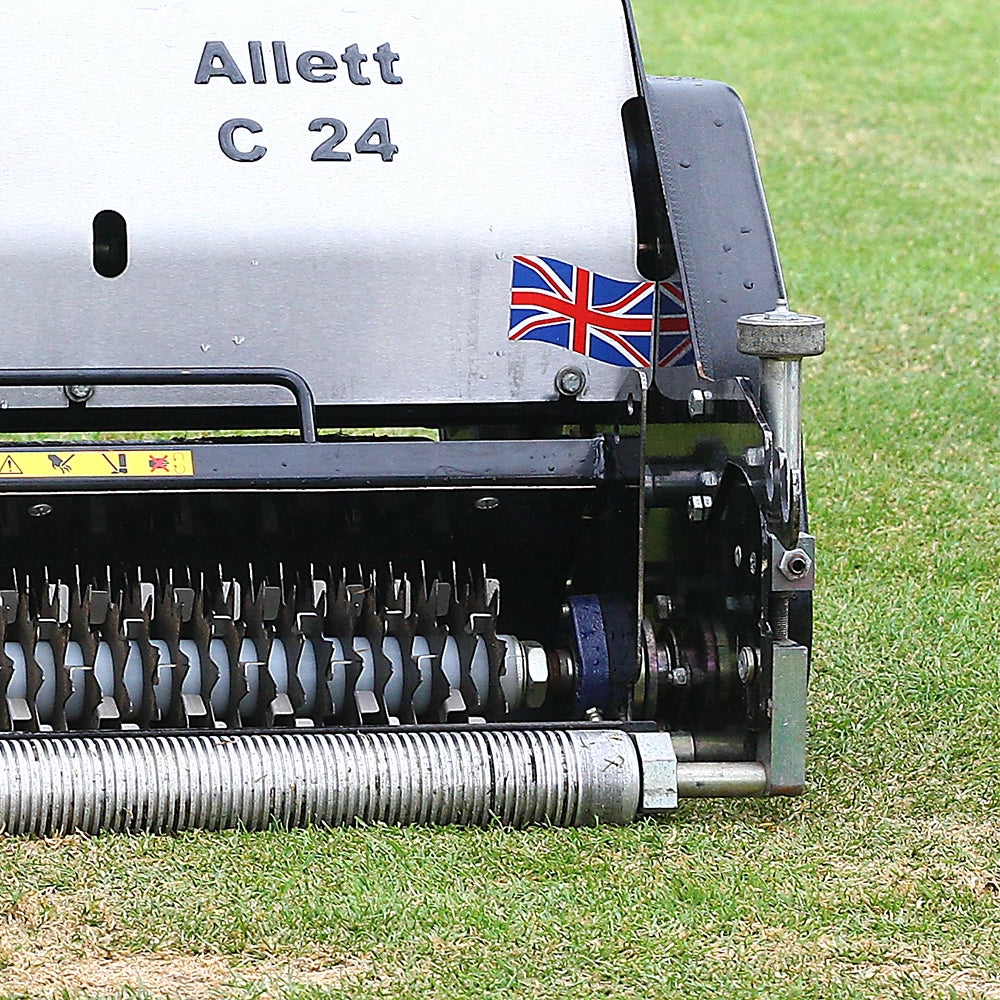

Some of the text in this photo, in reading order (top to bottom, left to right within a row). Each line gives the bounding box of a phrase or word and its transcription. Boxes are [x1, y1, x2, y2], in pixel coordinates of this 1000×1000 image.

[194, 40, 404, 86] Allett
[218, 117, 399, 163] C 24
